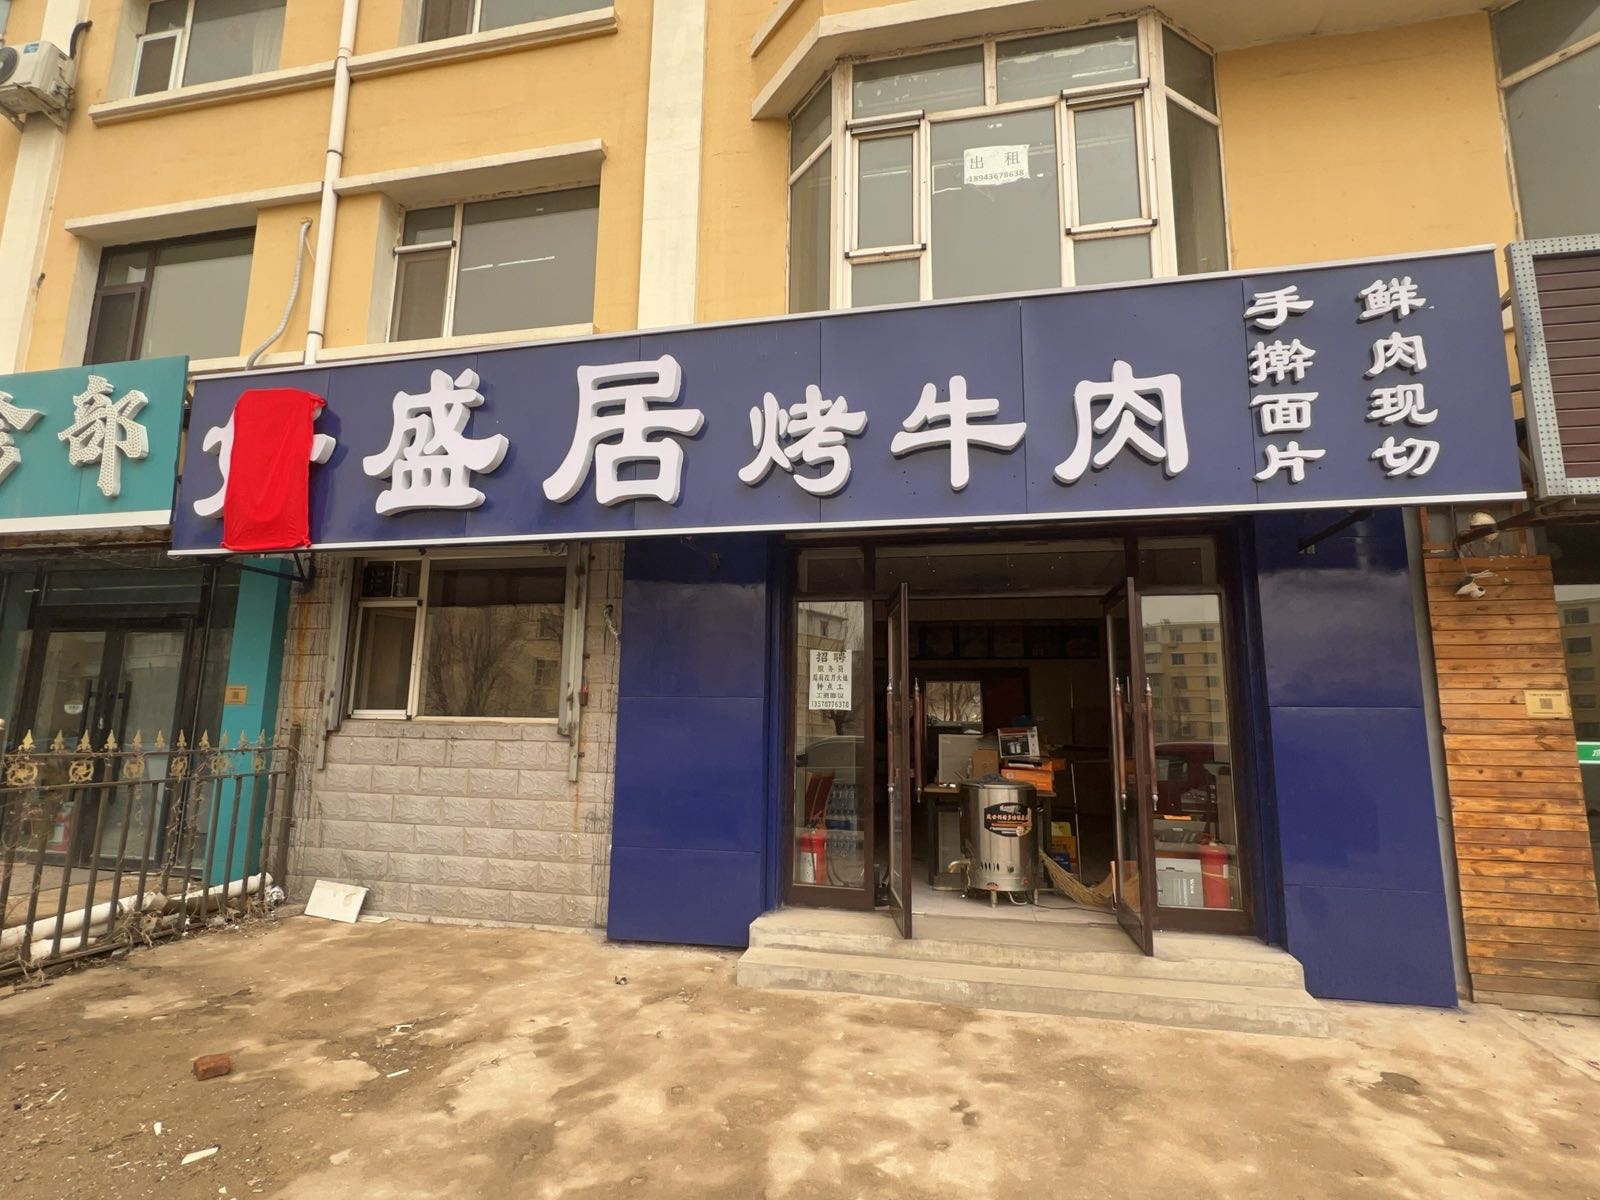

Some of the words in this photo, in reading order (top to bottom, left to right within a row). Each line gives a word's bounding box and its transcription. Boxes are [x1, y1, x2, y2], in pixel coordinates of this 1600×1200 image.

[970, 151, 1020, 169] 出租
[968, 170, 1024, 182] 18943678638
[1243, 285, 1326, 483] 手擀面片
[1358, 276, 1440, 477] 鲜肉现切
[816, 652, 846, 662] 招聘
